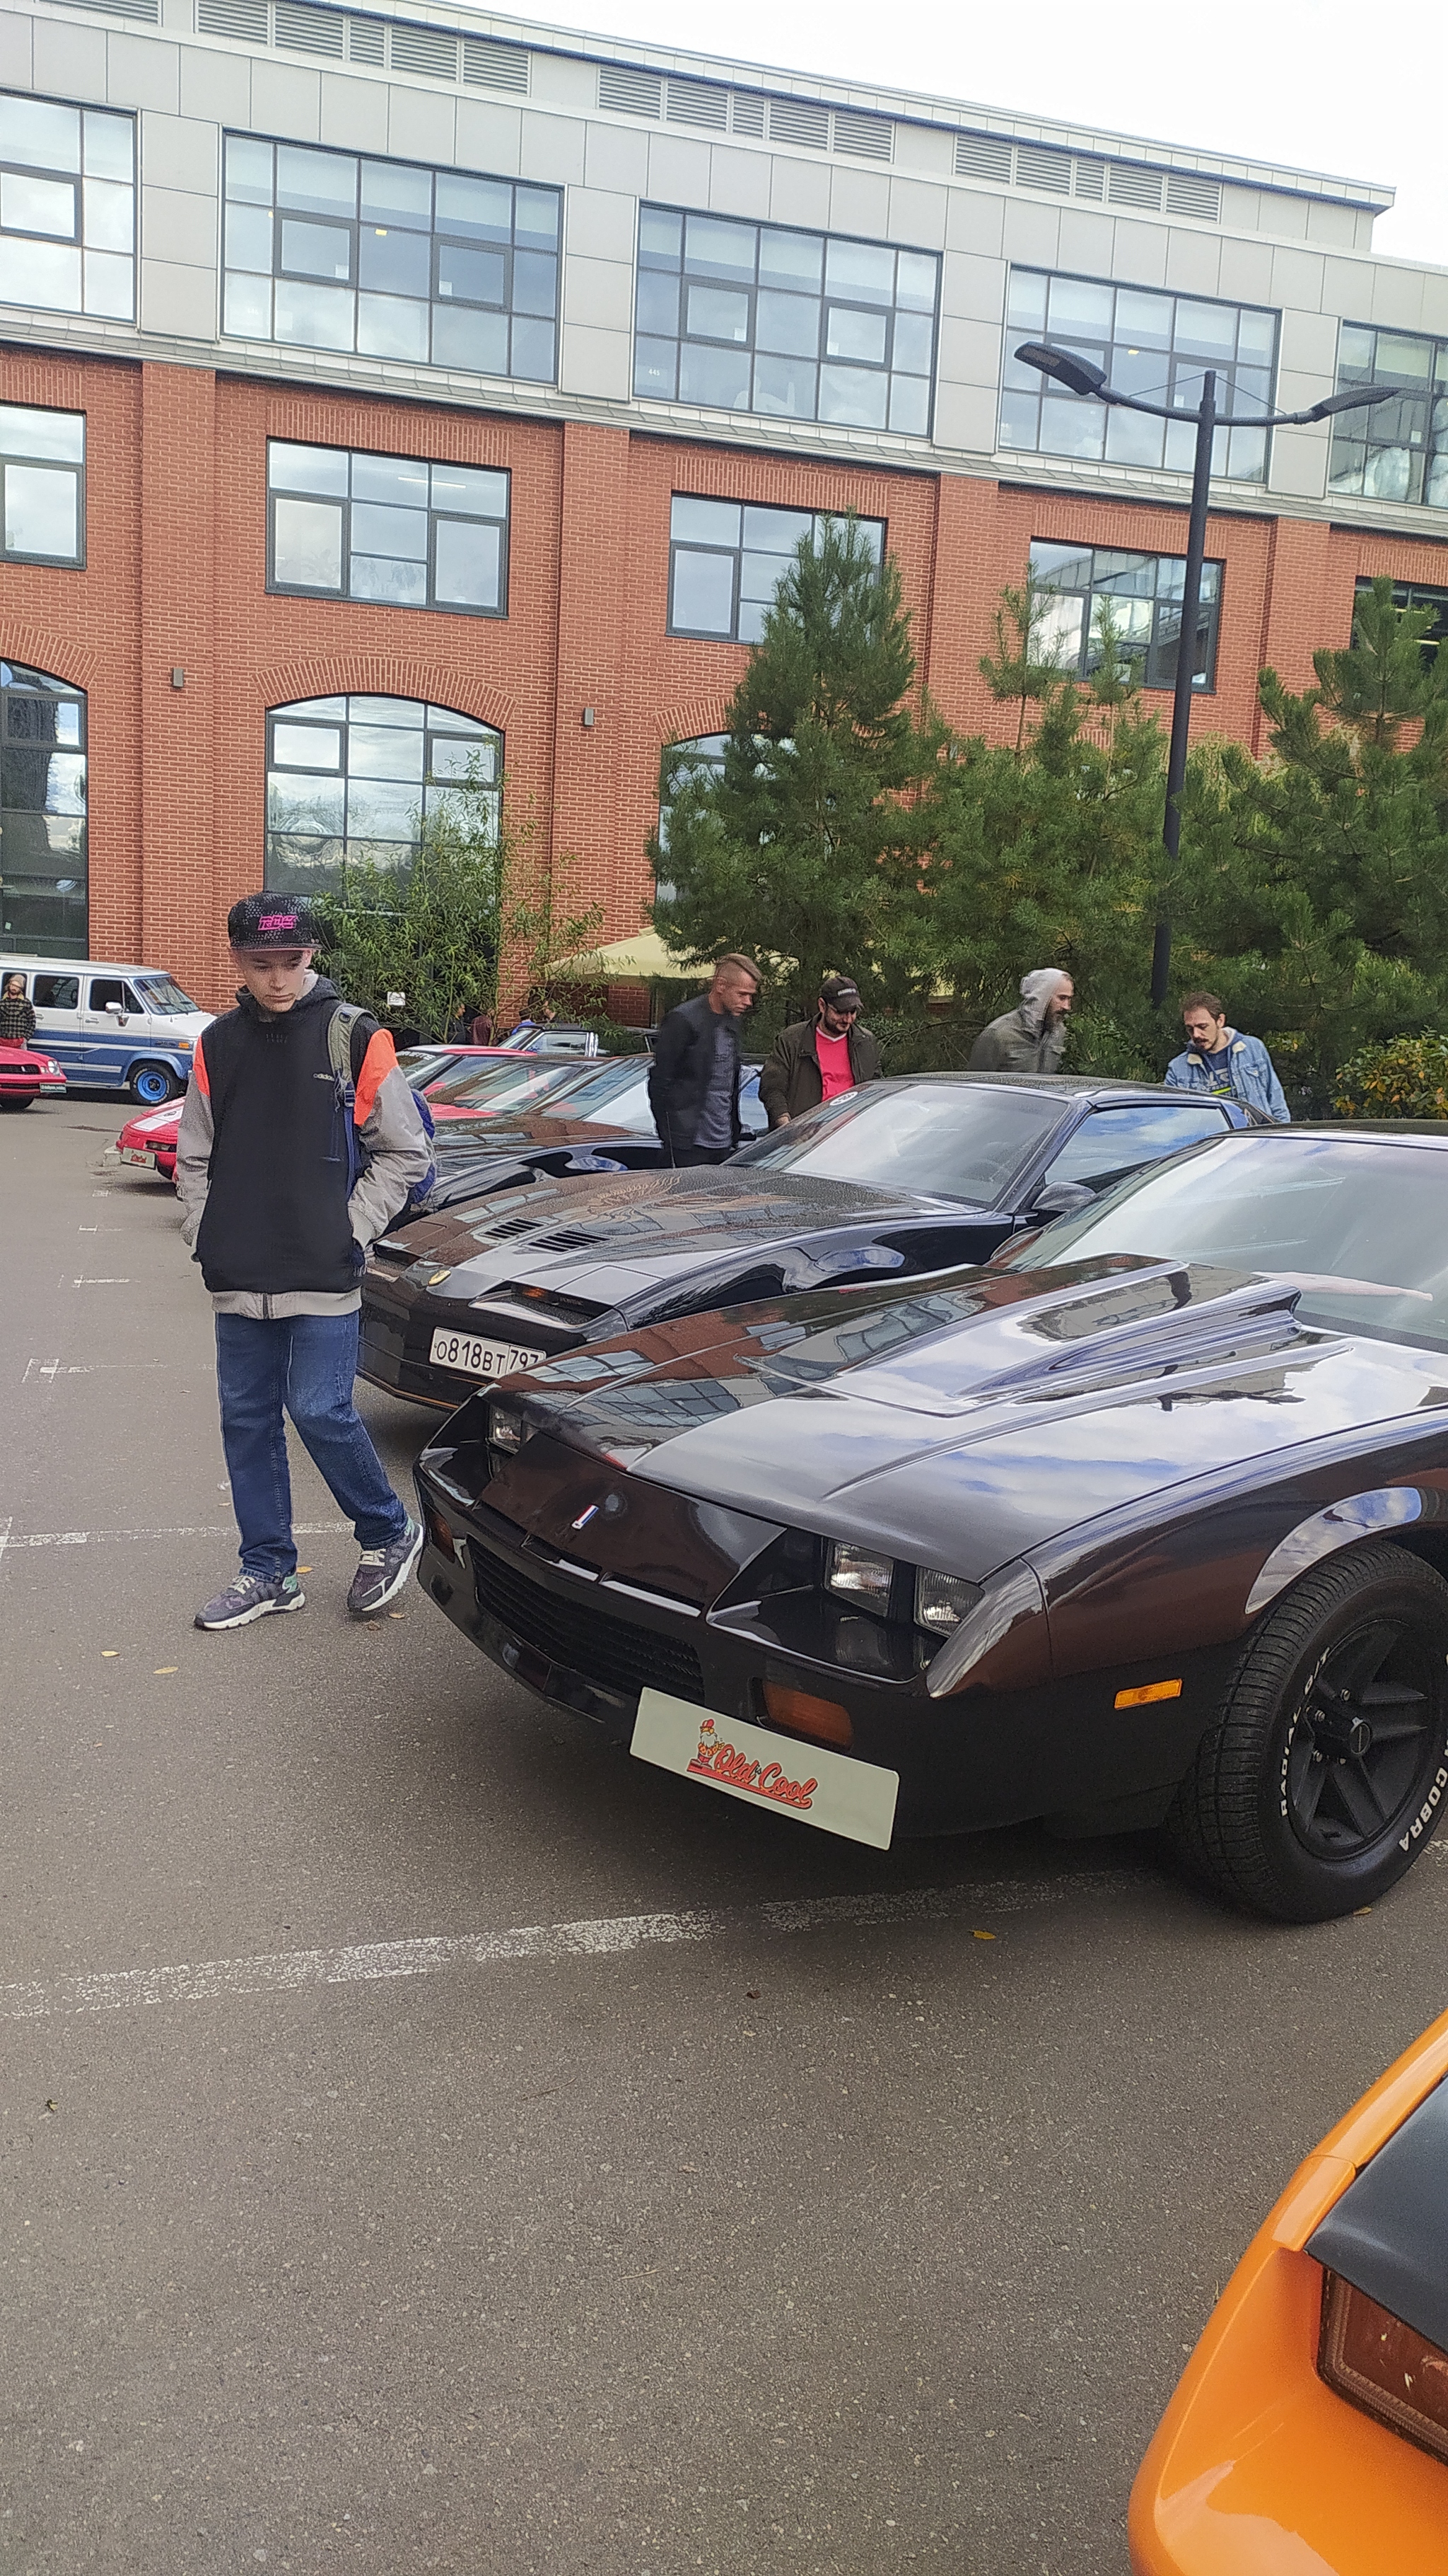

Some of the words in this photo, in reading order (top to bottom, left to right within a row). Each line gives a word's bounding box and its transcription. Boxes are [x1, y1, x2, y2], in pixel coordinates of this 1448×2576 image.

[257, 914, 298, 931] RDS
[714, 1743, 759, 1784] Old
[754, 1764, 762, 1776] is
[758, 1762, 819, 1805] Cool
[1280, 1706, 1302, 1817] RADIAL
[1399, 1767, 1448, 1852] COBRA
